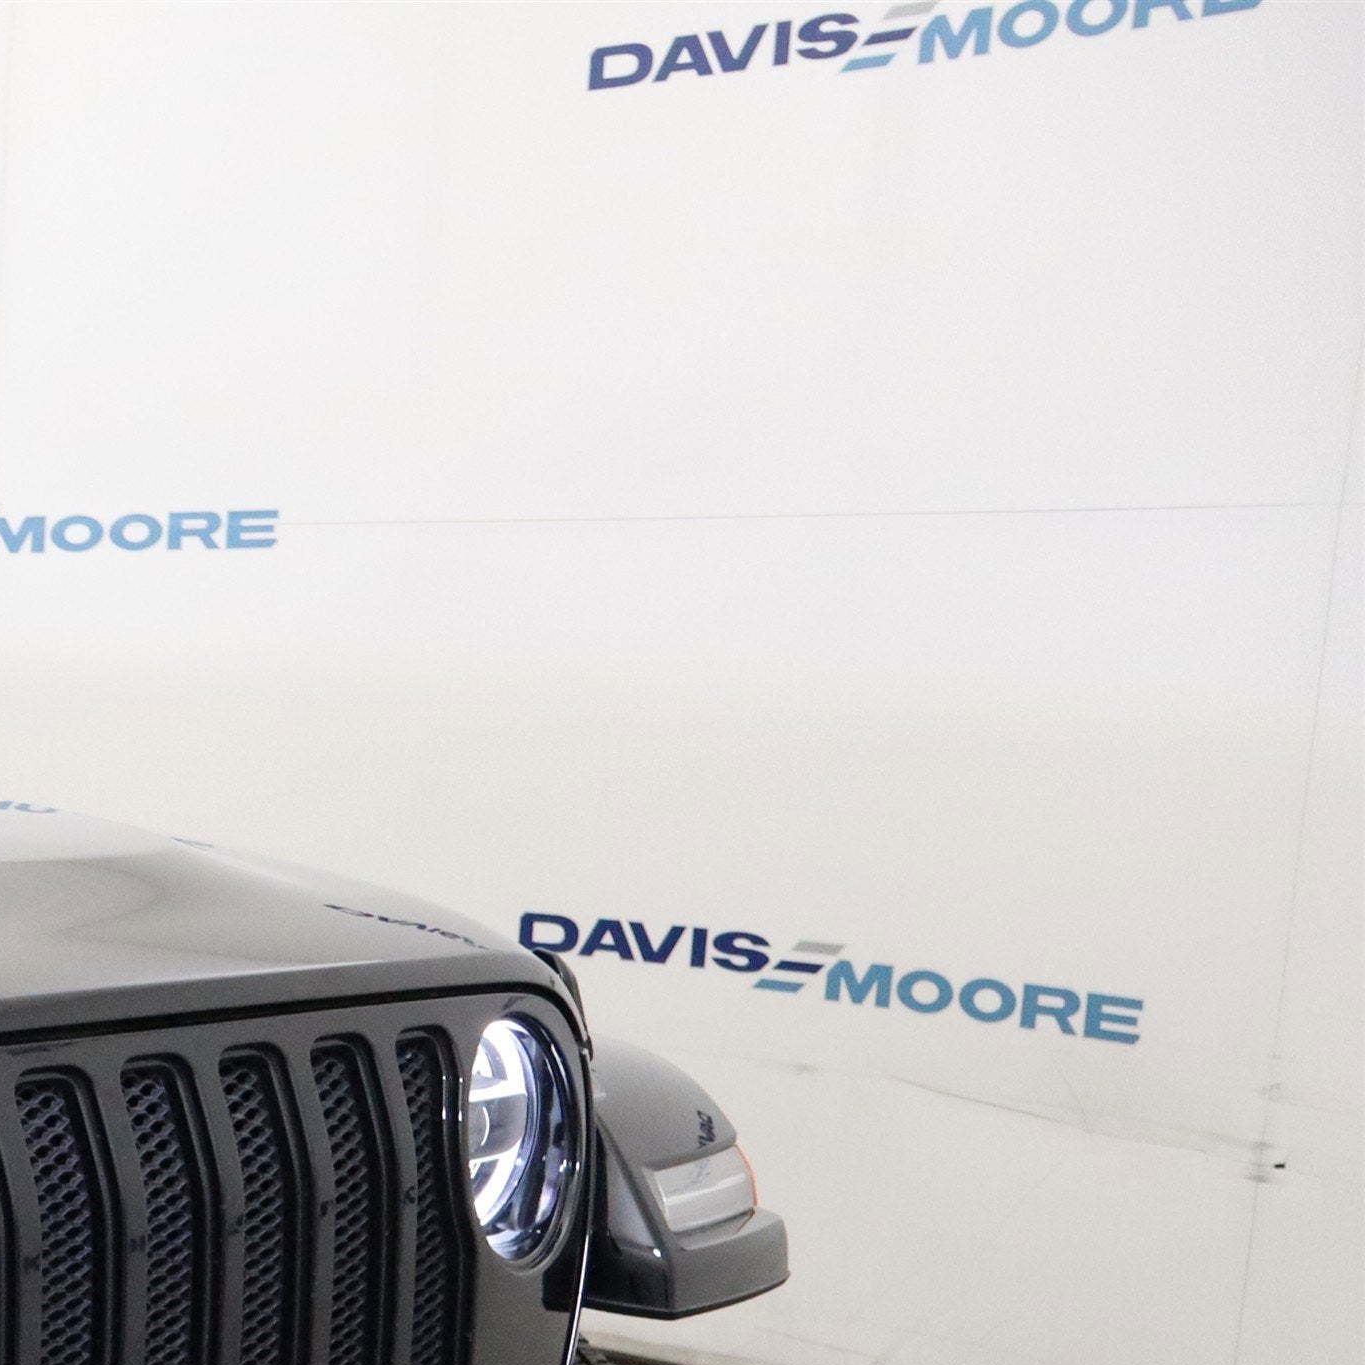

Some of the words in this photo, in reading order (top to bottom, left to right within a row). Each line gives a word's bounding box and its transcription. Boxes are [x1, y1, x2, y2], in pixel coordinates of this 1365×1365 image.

[588, 13, 859, 92] DAVIS
[518, 911, 772, 973] DAVIS
[825, 960, 1144, 1044] MOORE
